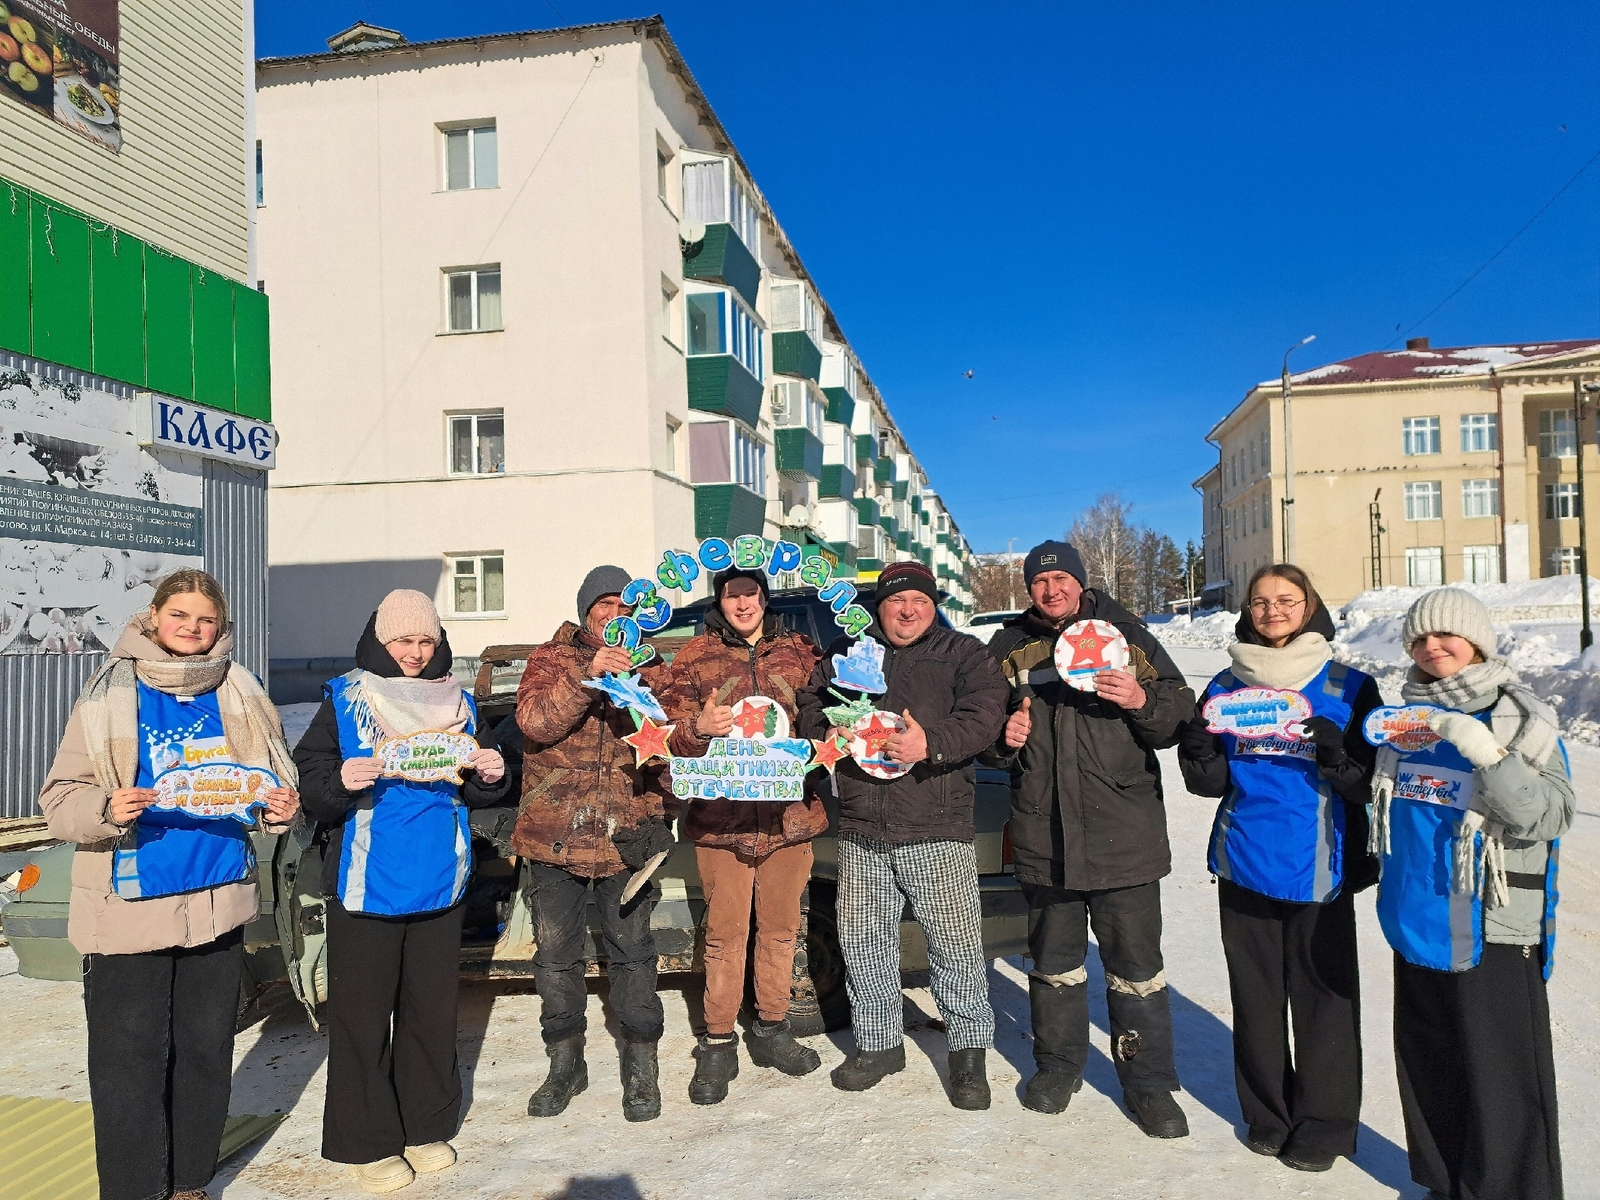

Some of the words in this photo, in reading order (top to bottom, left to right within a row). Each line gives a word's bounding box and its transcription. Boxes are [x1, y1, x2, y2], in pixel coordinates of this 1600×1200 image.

[74, 21, 115, 54] ОБЕДЫ
[158, 402, 271, 460] КАФЕ
[32, 500, 94, 515] ПОМИНАЛЬНЫХ
[101, 520, 112, 528] НА
[112, 521, 133, 530] ЗАКАЗ
[30, 524, 43, 533] ул.
[166, 537, 196, 548] 7-34-44
[1079, 638, 1096, 650] 23
[1221, 699, 1289, 716] МИРНОГО
[412, 744, 446, 758] БУДЬ
[709, 739, 767, 758] ДЕНЬ
[399, 756, 457, 771] СМЕЛЫМ!
[672, 758, 806, 778] ЗАЩИТНИКА
[193, 778, 242, 792] СИЛЫ
[672, 778, 803, 799] ОТЕЧЕСТВА
[175, 794, 188, 807] И
[190, 792, 257, 807] ОТВАГИ!
